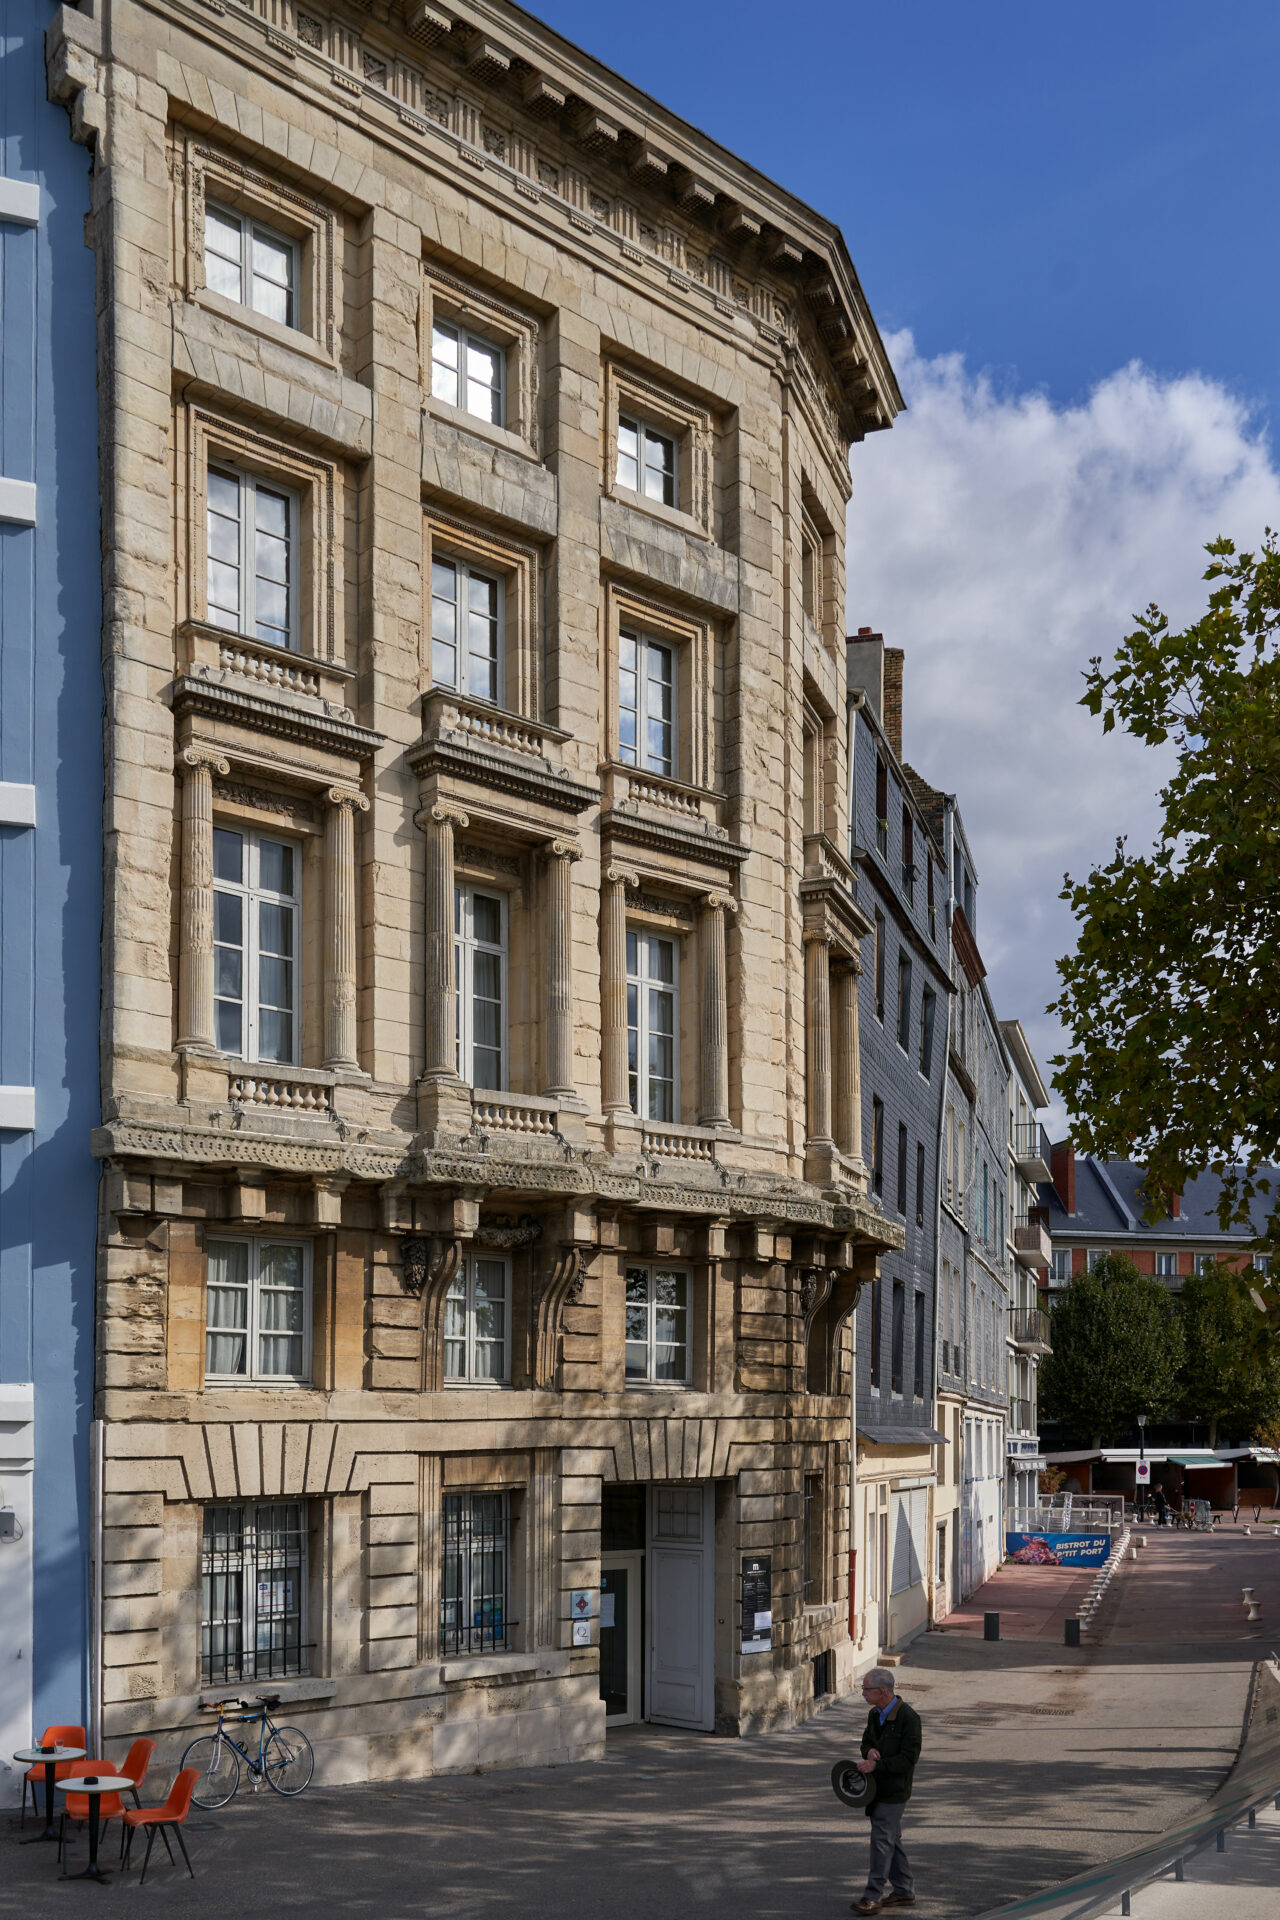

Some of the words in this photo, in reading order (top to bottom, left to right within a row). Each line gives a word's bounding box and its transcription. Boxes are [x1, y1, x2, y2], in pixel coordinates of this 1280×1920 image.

[1056, 1541, 1090, 1549] BISTROT
[1057, 1549, 1077, 1557] P'TIT
[1081, 1548, 1103, 1556] PORT
